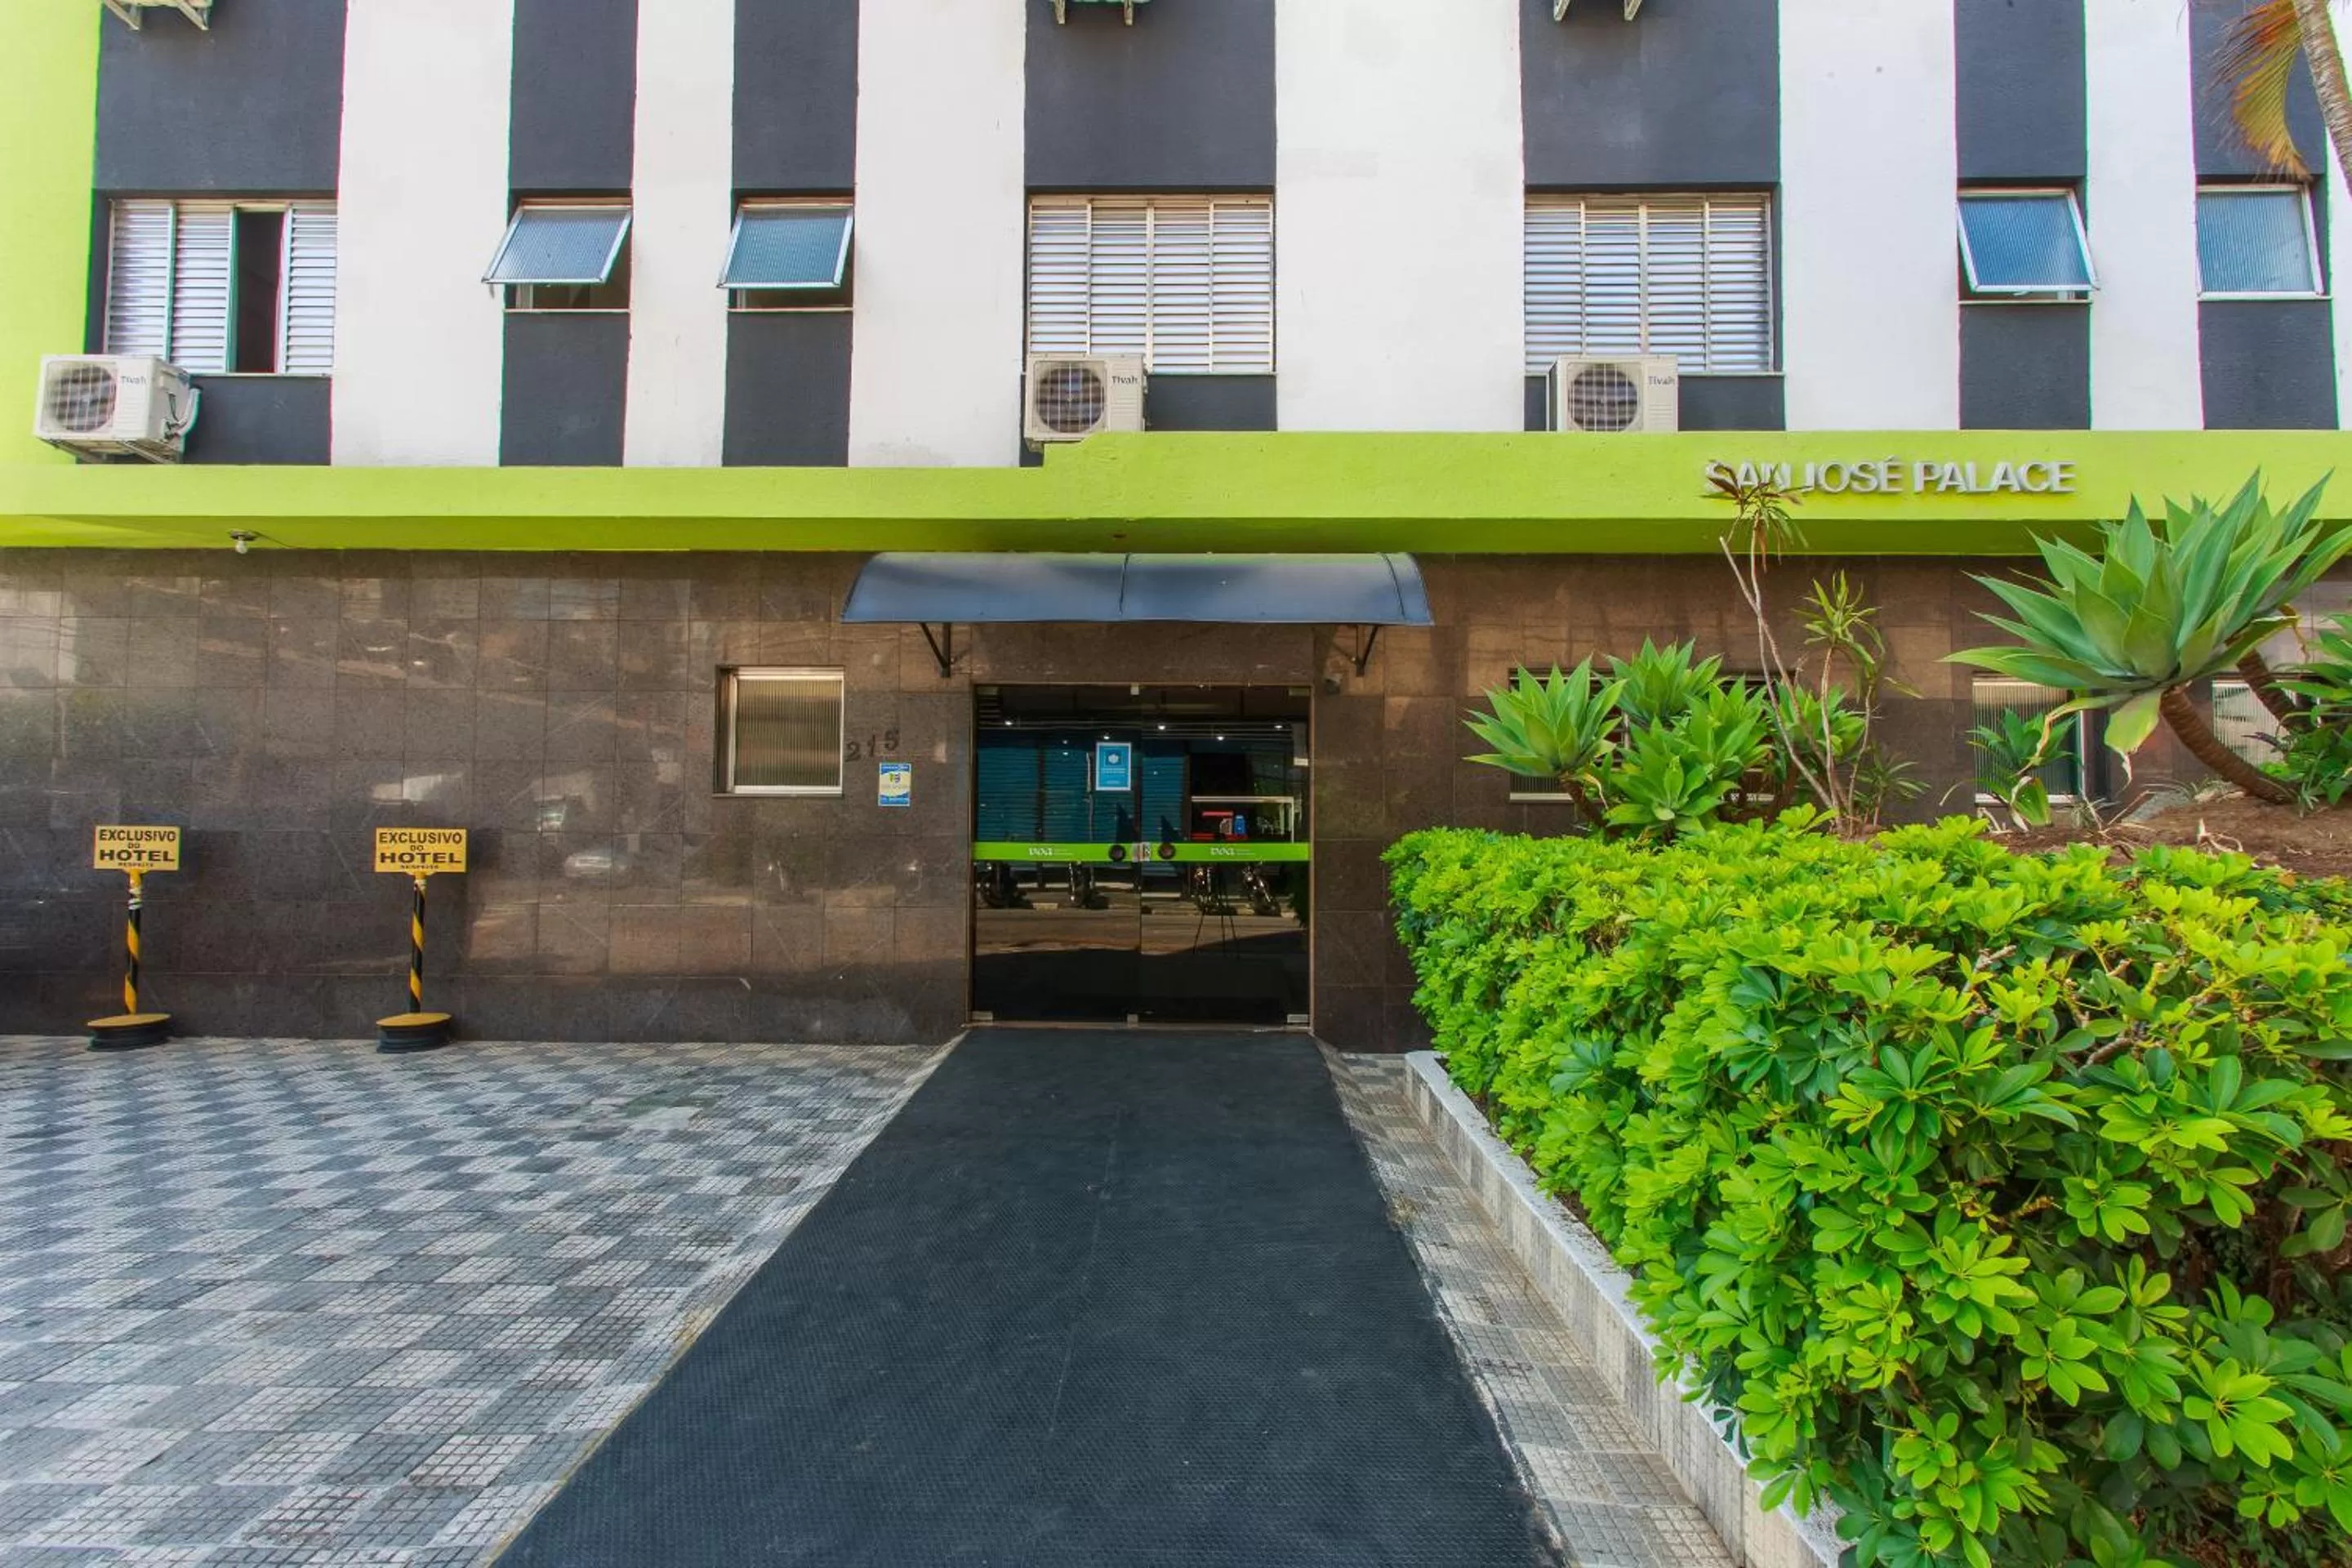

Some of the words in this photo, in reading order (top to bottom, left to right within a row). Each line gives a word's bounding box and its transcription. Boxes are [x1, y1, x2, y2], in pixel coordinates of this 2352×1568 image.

[1111, 375, 1138, 385] Tivah
[1802, 454, 1903, 494] JOSÉ
[1913, 461, 2076, 493] PALACE
[844, 728, 900, 763] 215
[99, 829, 176, 842] EXCLUSIVO
[378, 831, 463, 844] EXCLUSIVO
[99, 849, 176, 862] HOTEL
[379, 852, 463, 863] HOTEL
